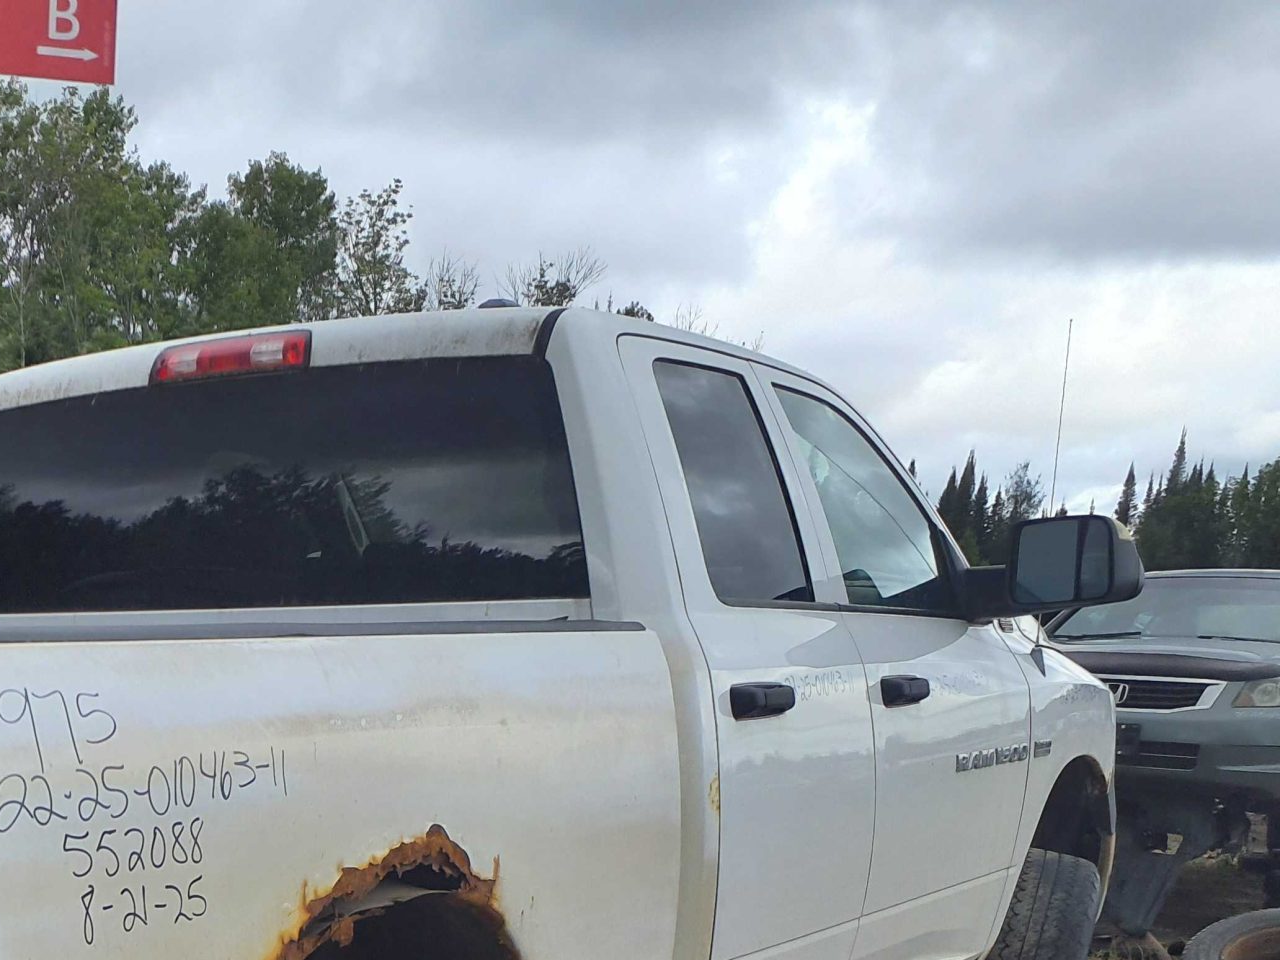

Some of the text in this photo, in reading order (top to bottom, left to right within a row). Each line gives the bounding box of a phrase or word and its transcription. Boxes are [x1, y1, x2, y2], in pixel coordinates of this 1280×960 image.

[48, 0, 80, 40] B
[62, 817, 204, 878] 552088
[80, 874, 208, 946] 8-21-25
